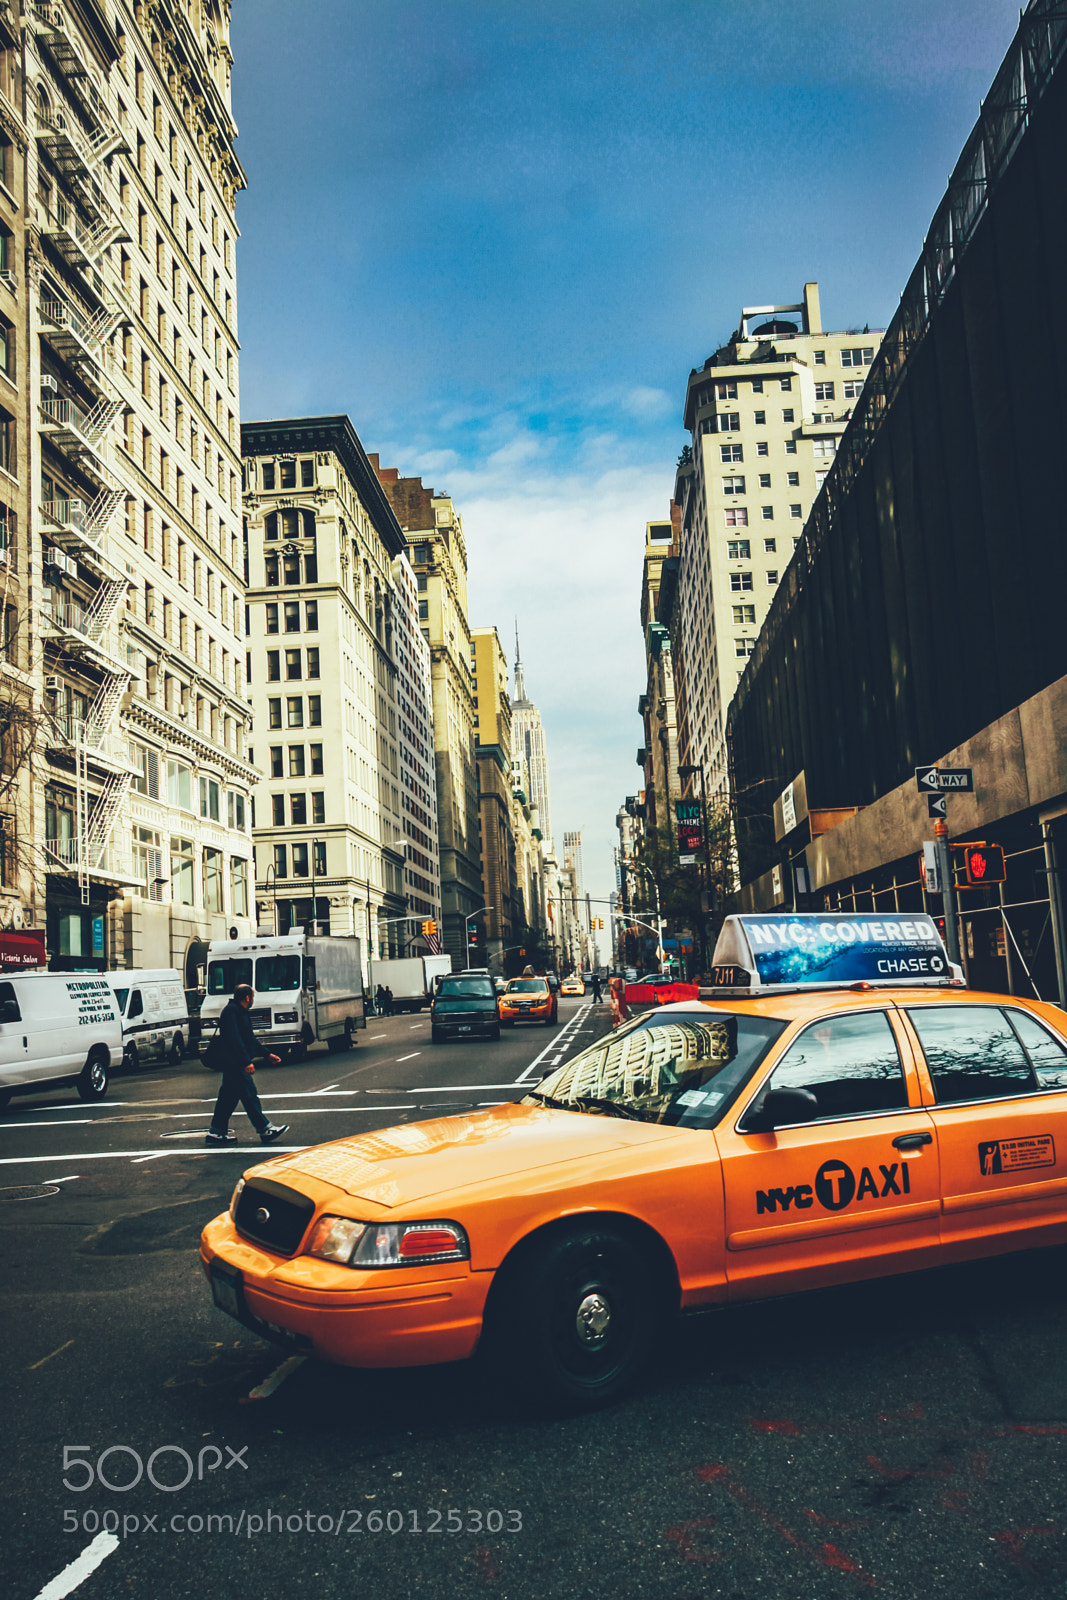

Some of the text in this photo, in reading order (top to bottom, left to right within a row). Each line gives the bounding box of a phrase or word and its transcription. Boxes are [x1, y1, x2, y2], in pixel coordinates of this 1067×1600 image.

[941, 775, 964, 786] WAY
[677, 805, 700, 819] NYC
[751, 921, 935, 944] NYC: COVERED
[1, 952, 38, 964] Victoria Salon
[877, 958, 929, 973] CHASE
[714, 967, 734, 985] 7J11
[66, 981, 109, 991] METROPOLITAN
[755, 1161, 911, 1215] NYC TAXI
